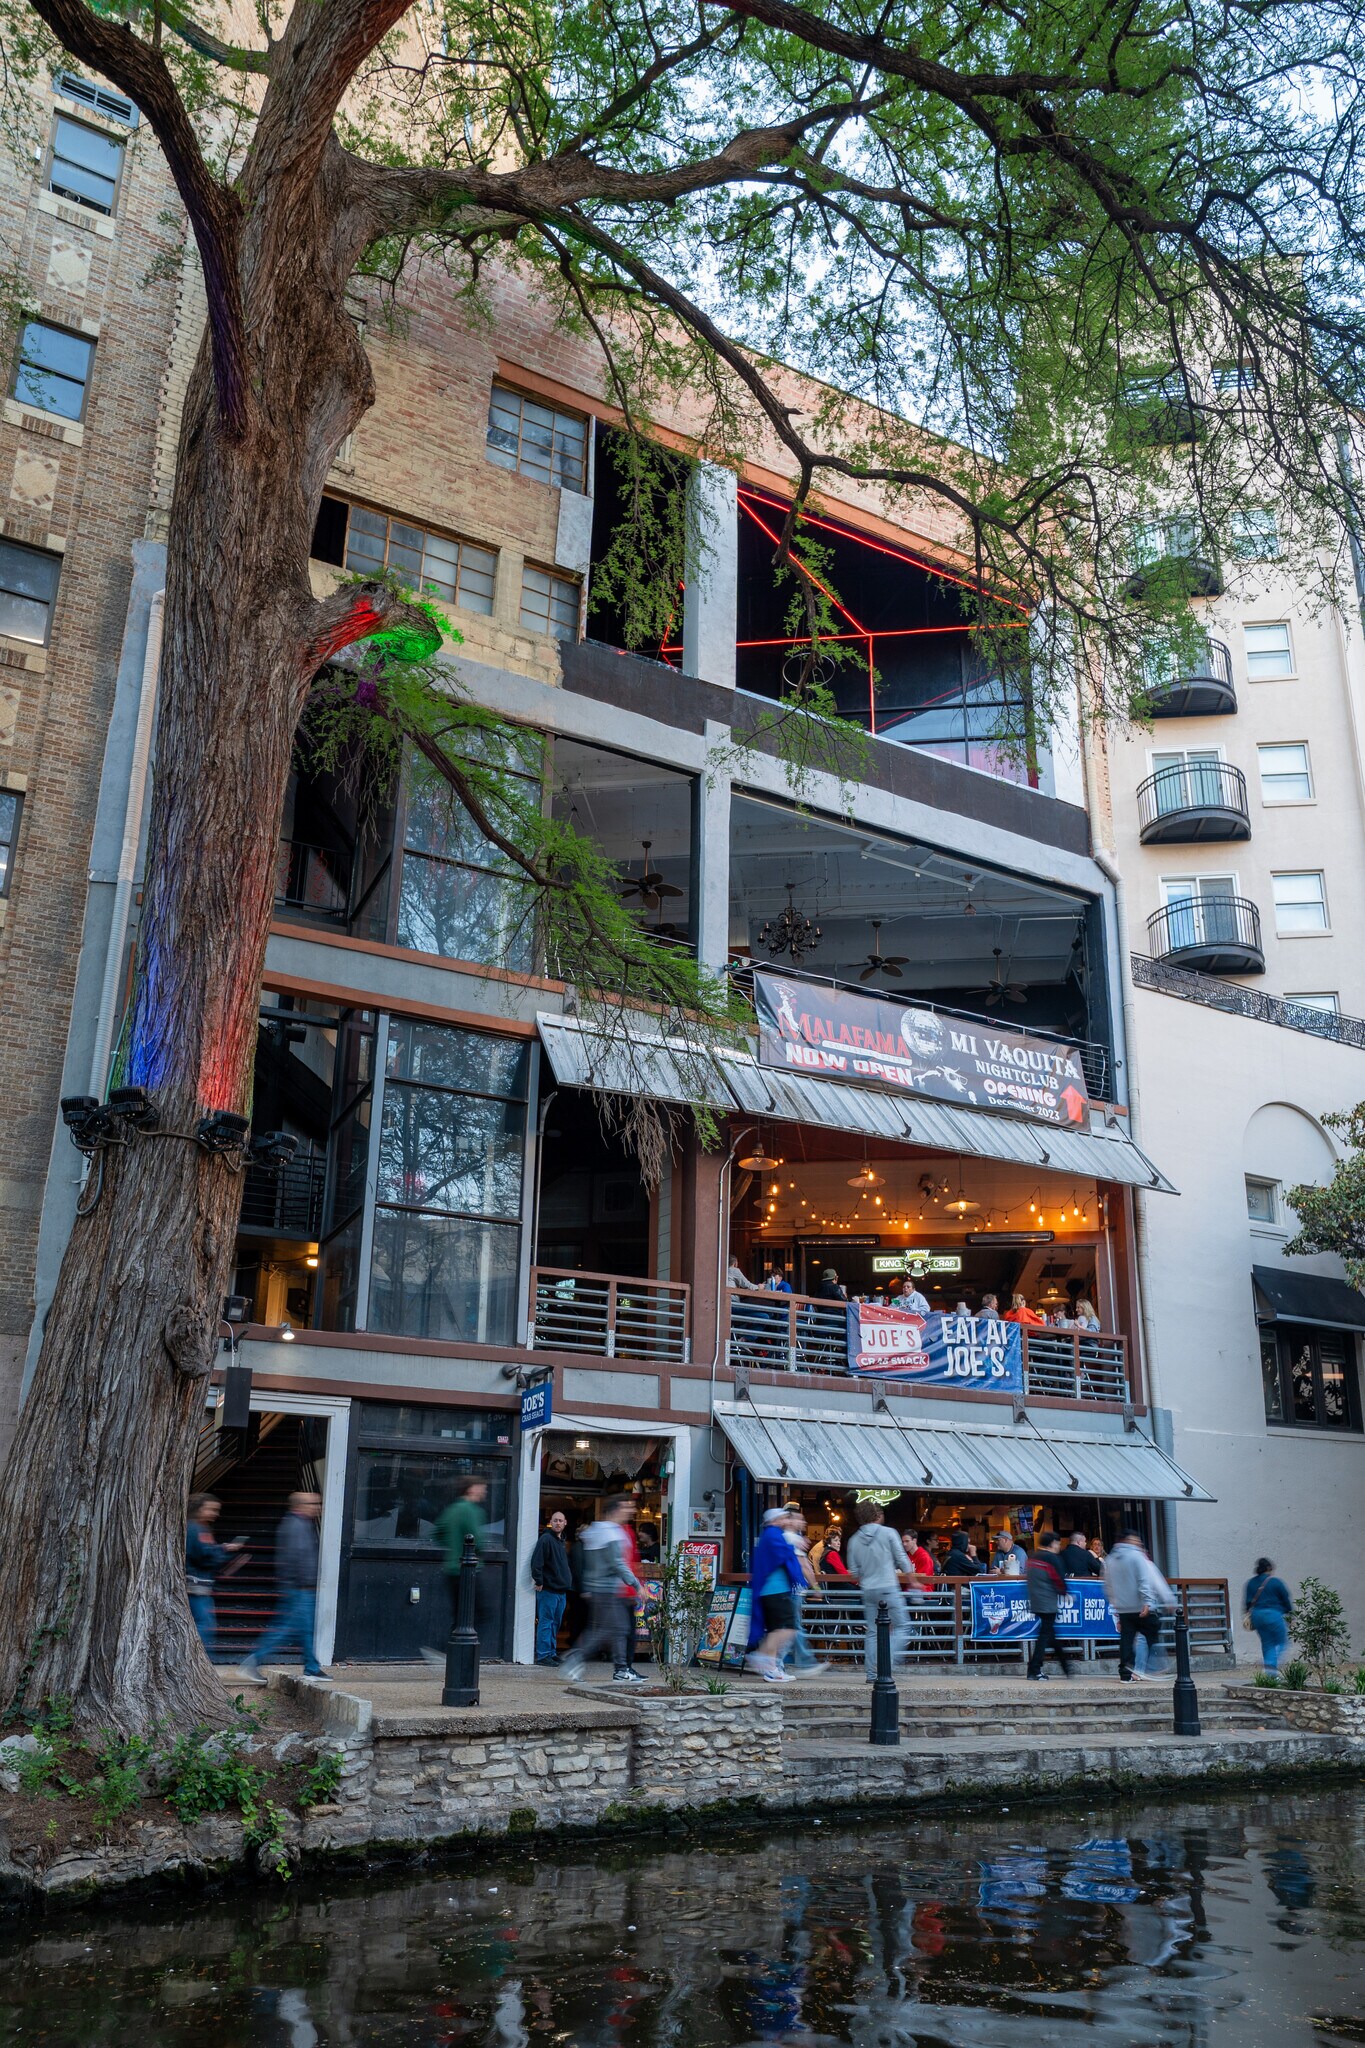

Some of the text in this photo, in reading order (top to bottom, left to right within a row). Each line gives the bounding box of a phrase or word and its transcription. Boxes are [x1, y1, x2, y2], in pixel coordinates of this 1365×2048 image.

[777, 1012, 912, 1058] MALAFAMA
[785, 1042, 847, 1071] NOW
[852, 1059, 914, 1087] OPEN
[949, 1030, 979, 1057] MI
[984, 1039, 1081, 1080] VAQUITA
[974, 1059, 1060, 1090] NIGHTCLUB
[983, 1079, 1057, 1107] OPENING
[987, 1096, 1061, 1121] December 2023
[879, 1260, 956, 1268] KING CRAB
[868, 1330, 916, 1348] JOE'S
[941, 1316, 1009, 1345] EAT AT
[891, 1356, 927, 1366] SHACK
[943, 1347, 1010, 1377] JOE'S.
[522, 1392, 545, 1414] JOE'S
[522, 1409, 544, 1422] CRAB SHACK
[712, 1595, 728, 1603] ROYAL
[1057, 1594, 1074, 1609] UD
[1084, 1598, 1106, 1608] EASY TO
[1084, 1609, 1106, 1621] ENJOY
